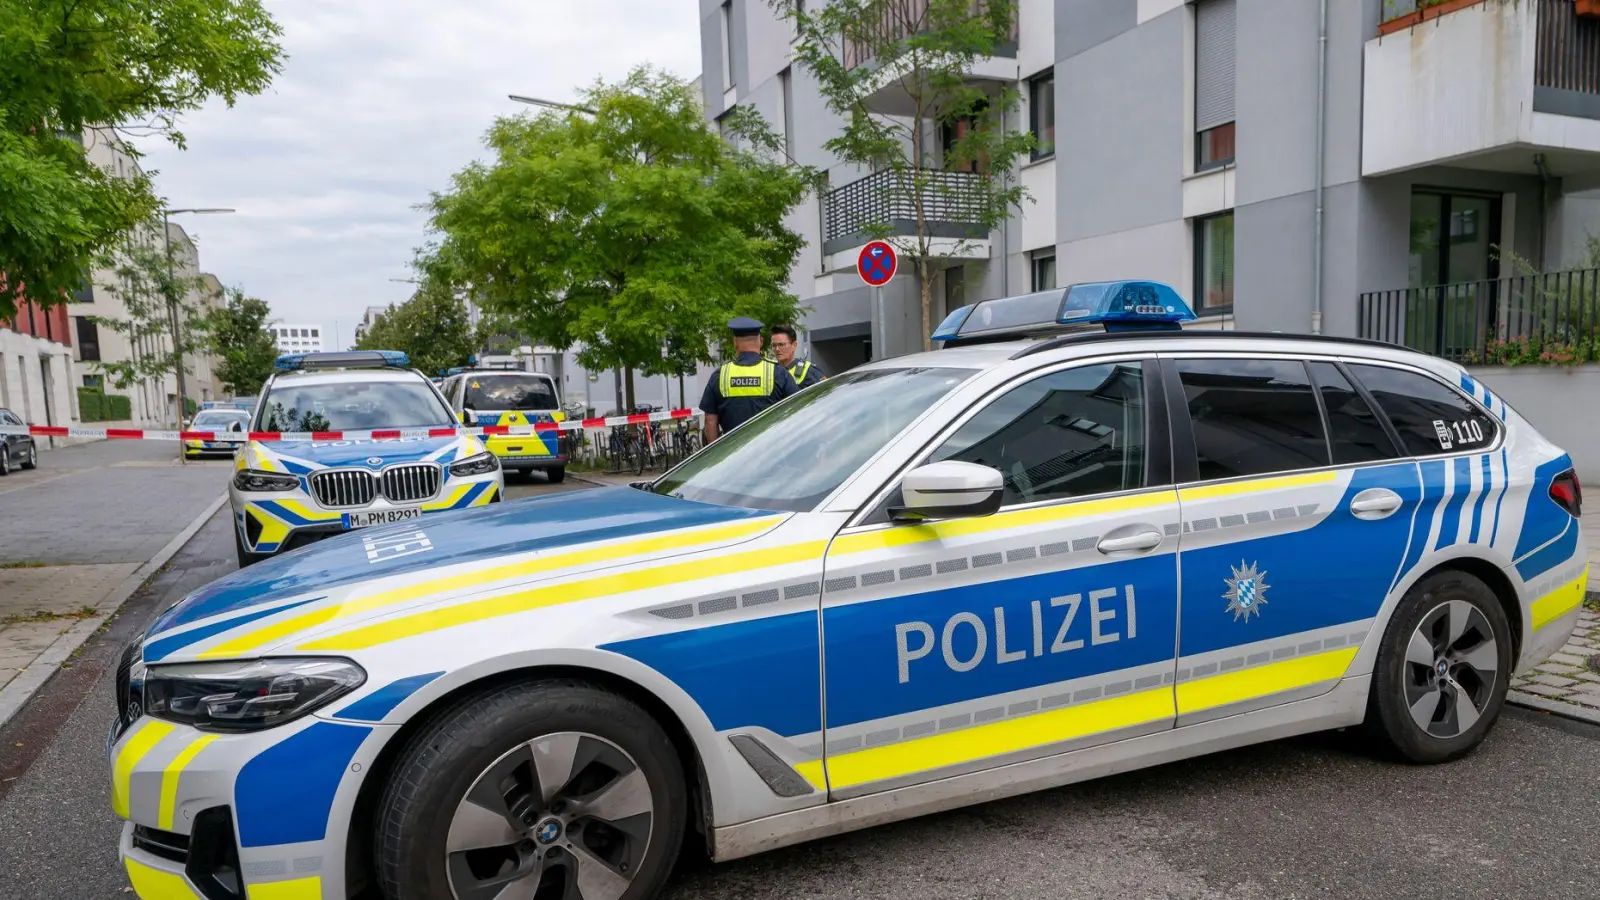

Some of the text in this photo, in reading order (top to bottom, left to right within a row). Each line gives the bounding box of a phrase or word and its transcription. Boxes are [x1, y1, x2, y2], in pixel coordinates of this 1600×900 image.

[731, 378, 760, 386] POLIZEI
[1452, 419, 1483, 444] 110
[350, 509, 418, 526] M PM 8291
[895, 584, 1136, 684] POLIZEI
